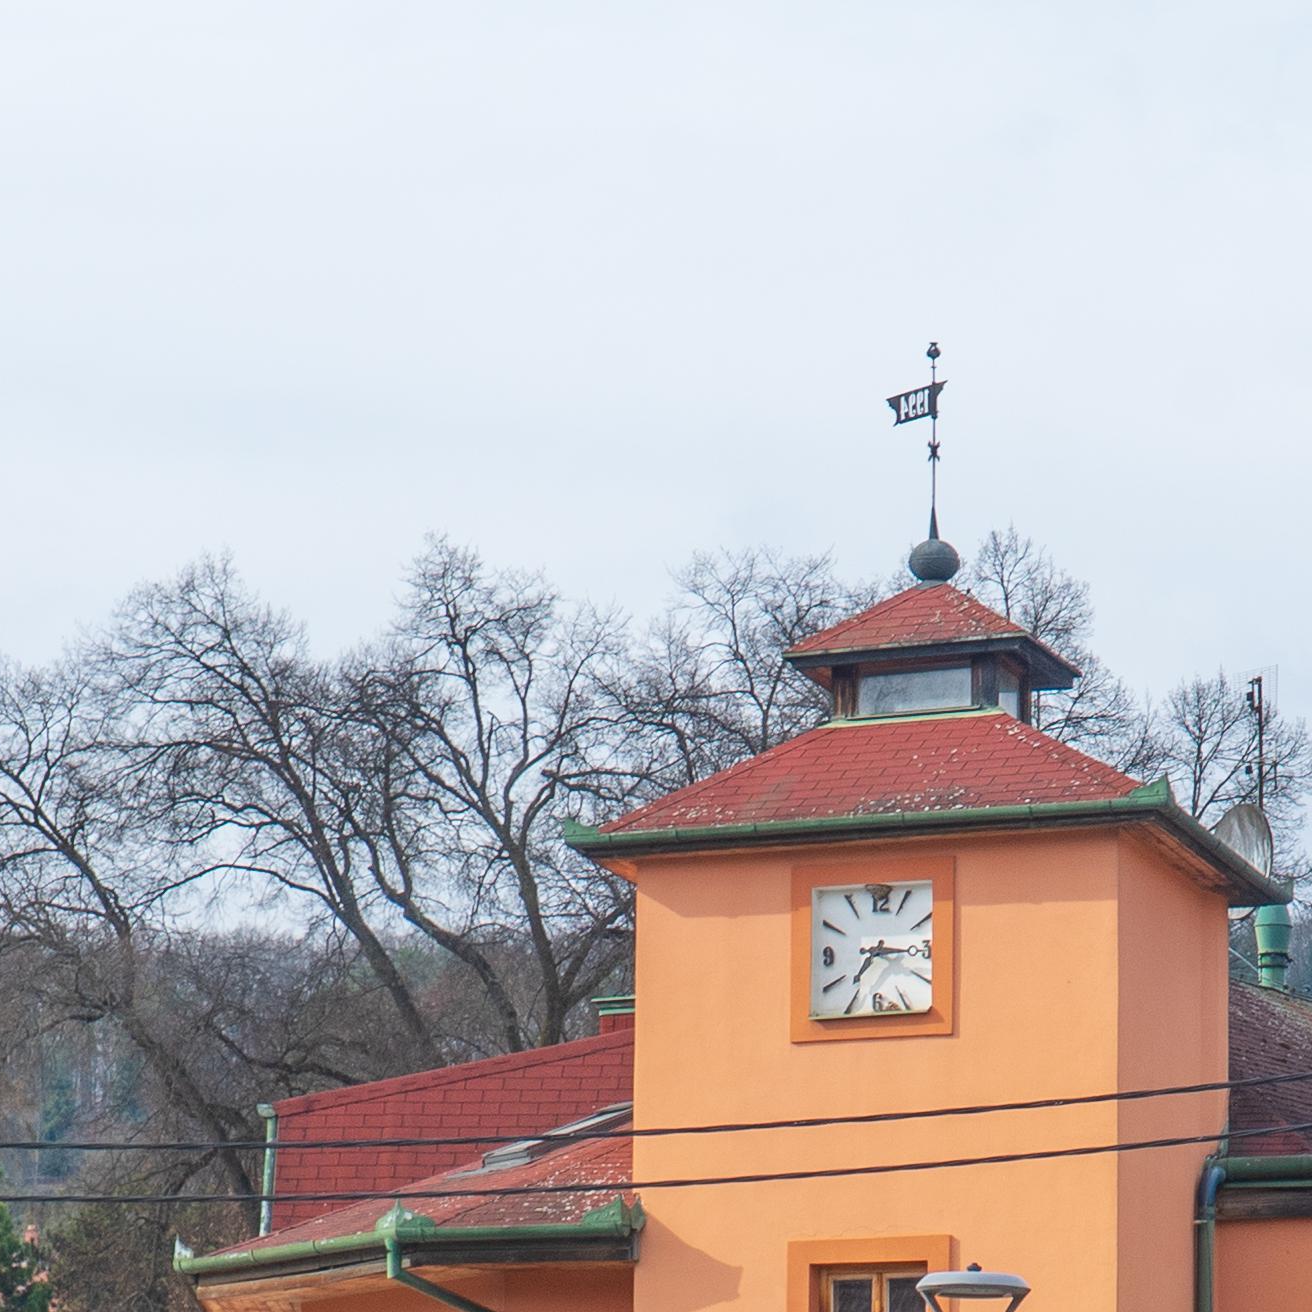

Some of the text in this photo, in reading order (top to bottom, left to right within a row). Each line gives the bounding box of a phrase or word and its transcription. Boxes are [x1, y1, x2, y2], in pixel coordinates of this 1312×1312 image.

[822, 939, 932, 967] 9 3
[872, 992, 883, 1013] 6
